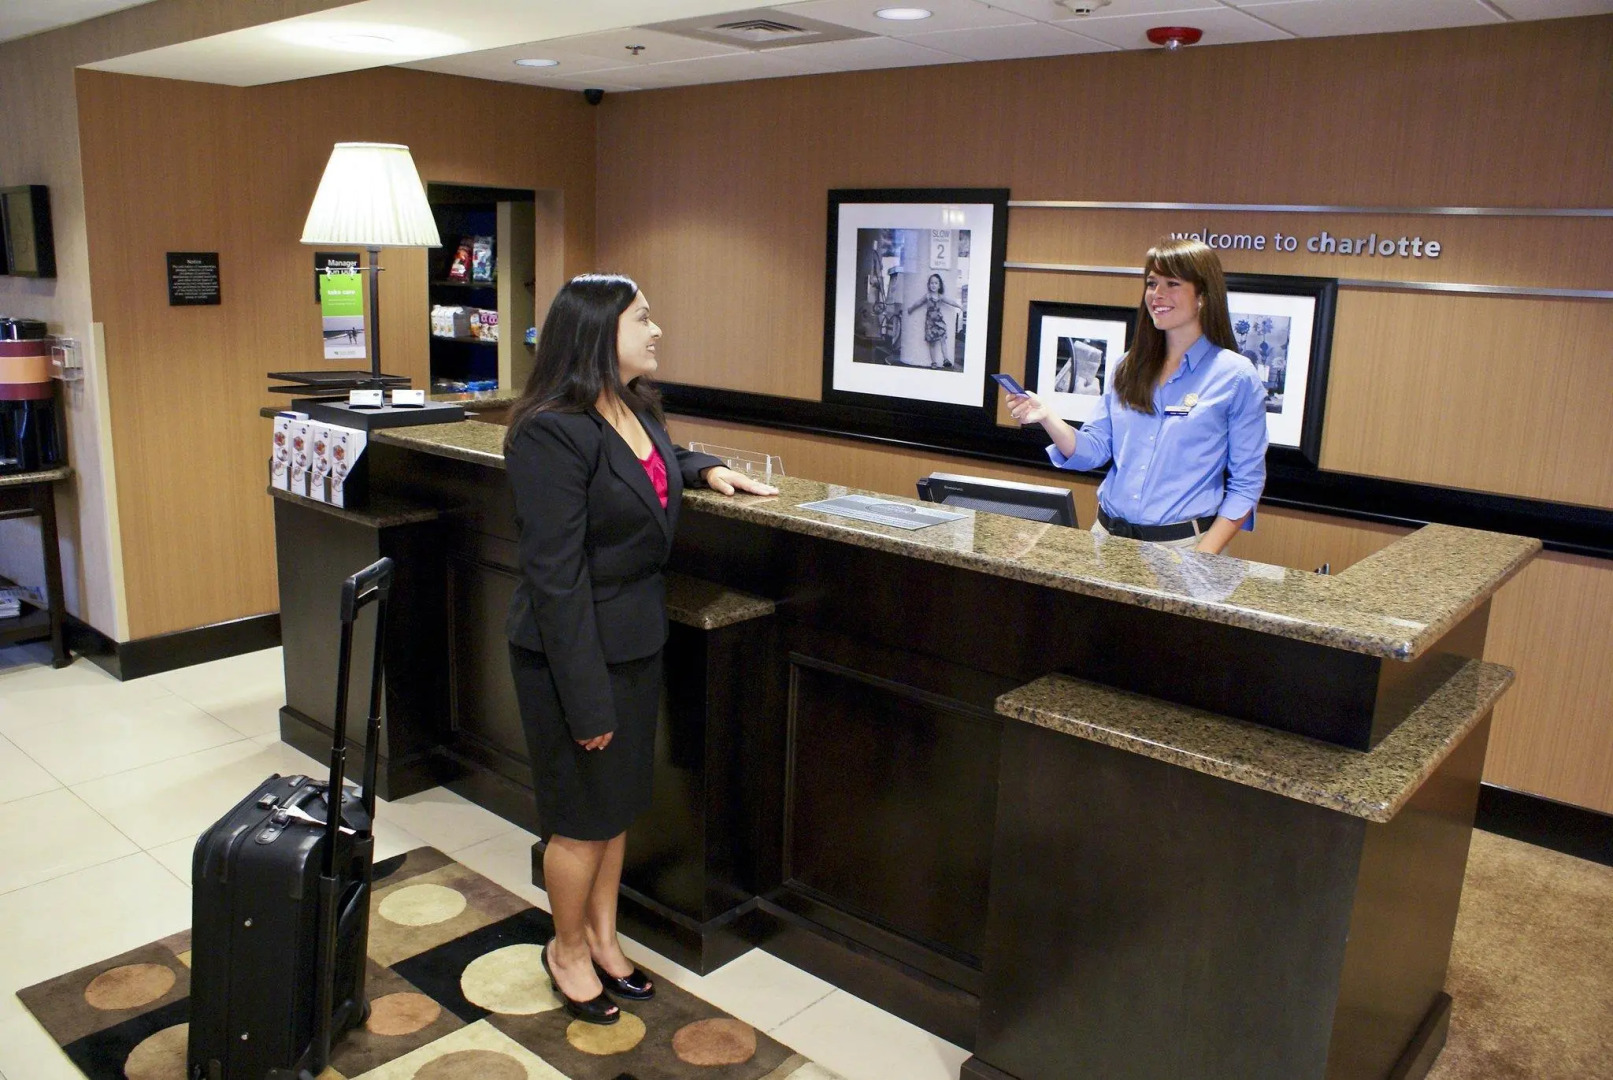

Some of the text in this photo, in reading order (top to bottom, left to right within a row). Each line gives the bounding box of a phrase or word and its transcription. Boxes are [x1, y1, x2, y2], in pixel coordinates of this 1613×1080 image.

[932, 229, 951, 238] SLOW
[1273, 232, 1298, 252] to
[1306, 231, 1442, 258] charlotte
[937, 244, 945, 259] 2
[327, 259, 358, 268] Manager
